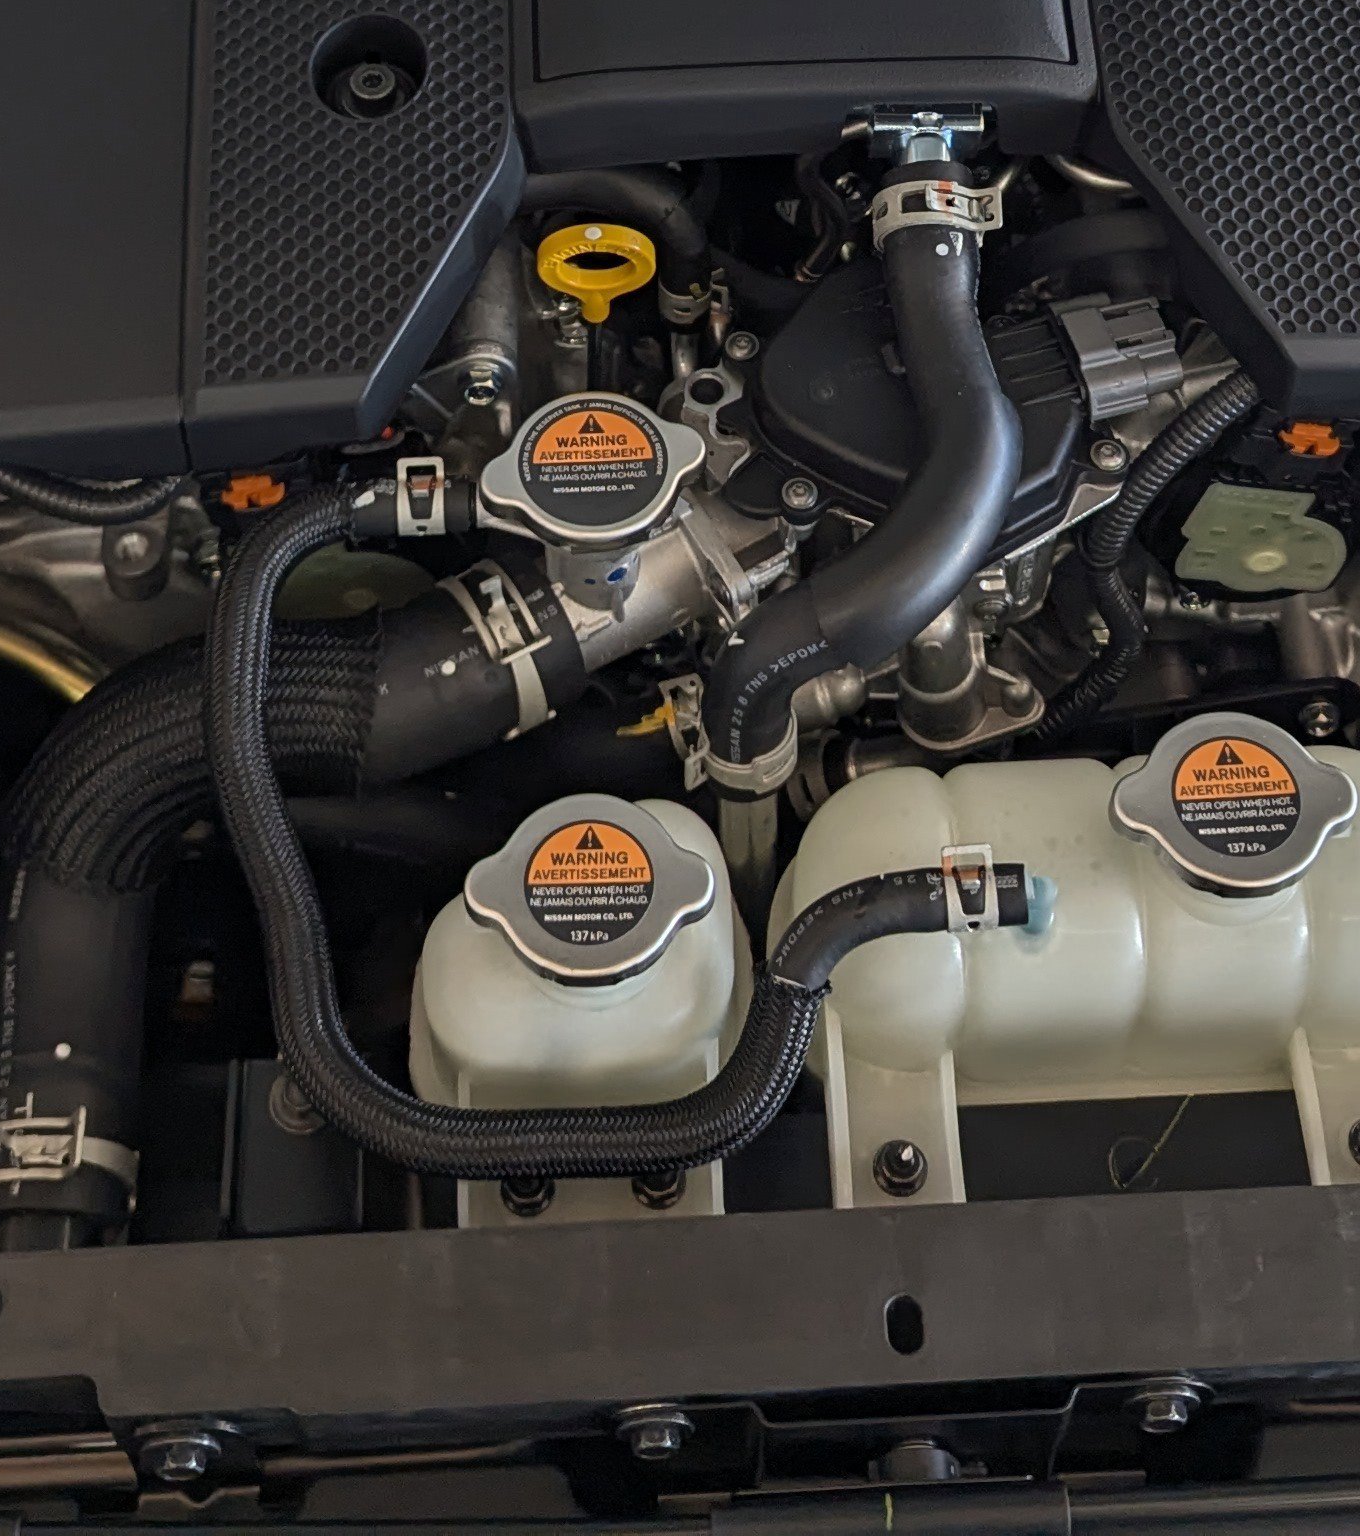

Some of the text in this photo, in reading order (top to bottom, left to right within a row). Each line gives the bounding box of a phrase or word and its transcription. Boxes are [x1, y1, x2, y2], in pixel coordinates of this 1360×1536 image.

[556, 434, 627, 448] WARNING
[539, 447, 646, 461] AVERTISSEMENT
[598, 463, 623, 471] WHEN
[552, 473, 579, 481] JAMAIS
[580, 472, 610, 480] OUVRIR
[1192, 766, 1270, 781] WARNING
[1180, 780, 1289, 796] AVERTISSEMENT
[1182, 802, 1212, 811] NEVER
[1214, 800, 1240, 809] OPEN
[1241, 799, 1270, 808] WHEN
[1182, 813, 1193, 821] NE
[1193, 812, 1224, 821] JAMAIS
[1225, 810, 1257, 819] OUVRIR
[1227, 843, 1266, 853] 137 kPa
[550, 851, 628, 865] WARNING
[533, 867, 646, 880] AVERTISSEMENT
[532, 887, 563, 895] NEVER
[565, 886, 591, 895] OPEN
[594, 886, 622, 894] WHEN
[530, 898, 542, 907] NE
[543, 898, 573, 907] JAMAIS
[575, 897, 607, 906] OUVRIR
[571, 931, 609, 942] 137 kPa
